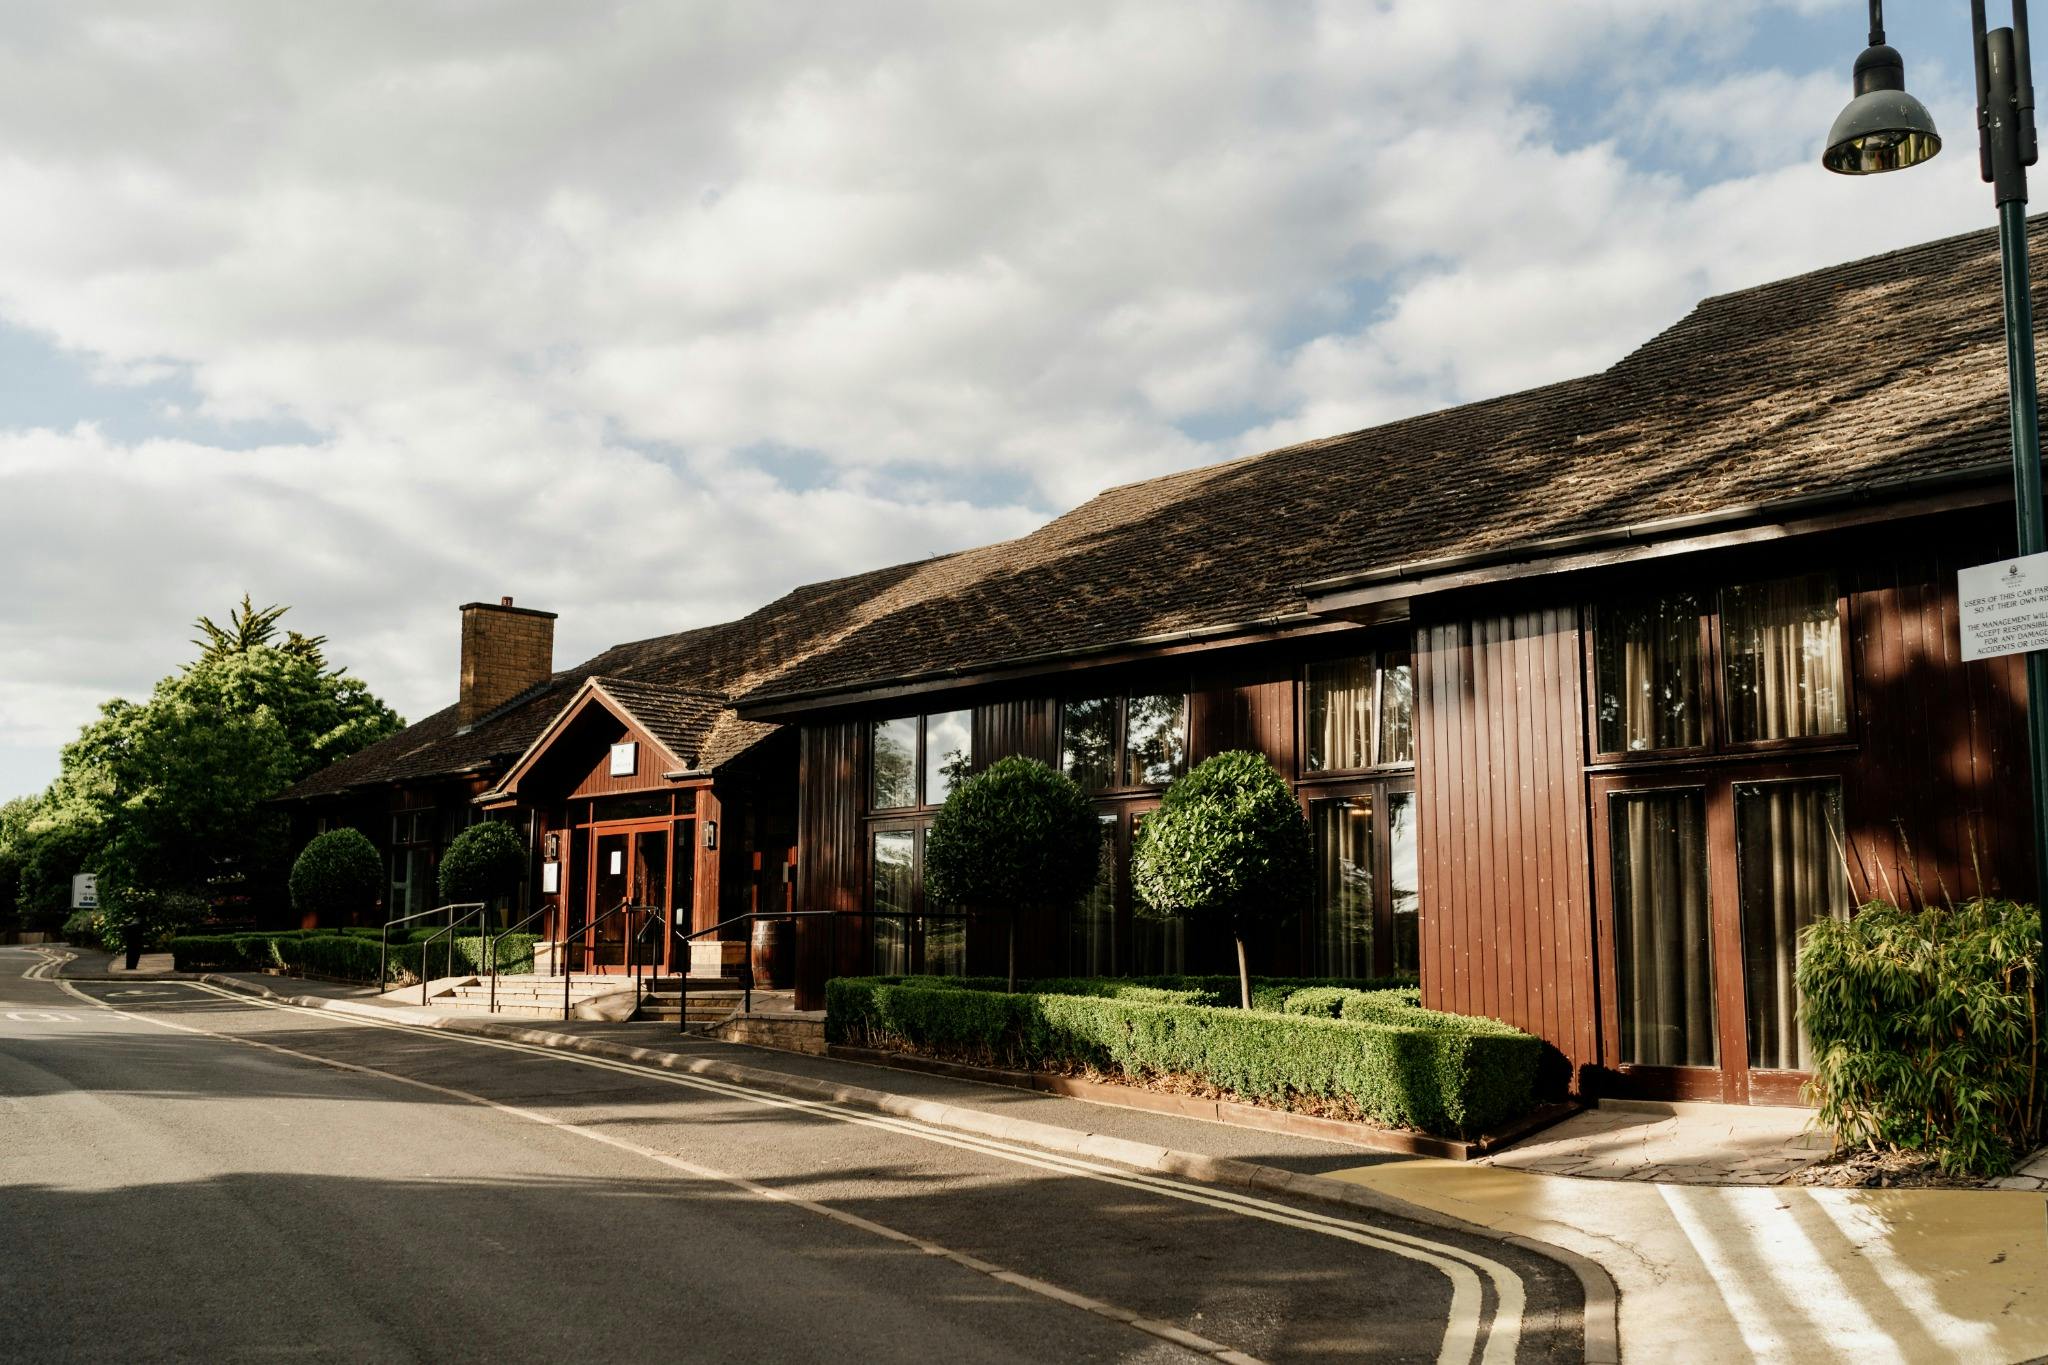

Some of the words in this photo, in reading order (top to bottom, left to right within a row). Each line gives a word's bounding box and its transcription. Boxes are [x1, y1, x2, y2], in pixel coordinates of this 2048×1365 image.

[1965, 598, 1985, 608] USERS
[2017, 588, 2032, 598] CAR
[1998, 600, 2017, 609] THEIR
[2020, 597, 2037, 606] OWN
[1983, 615, 2030, 628] MANAGEMENT
[1976, 628, 2000, 638] ACCEPT
[1977, 642, 2015, 655] ACCIDENTS
